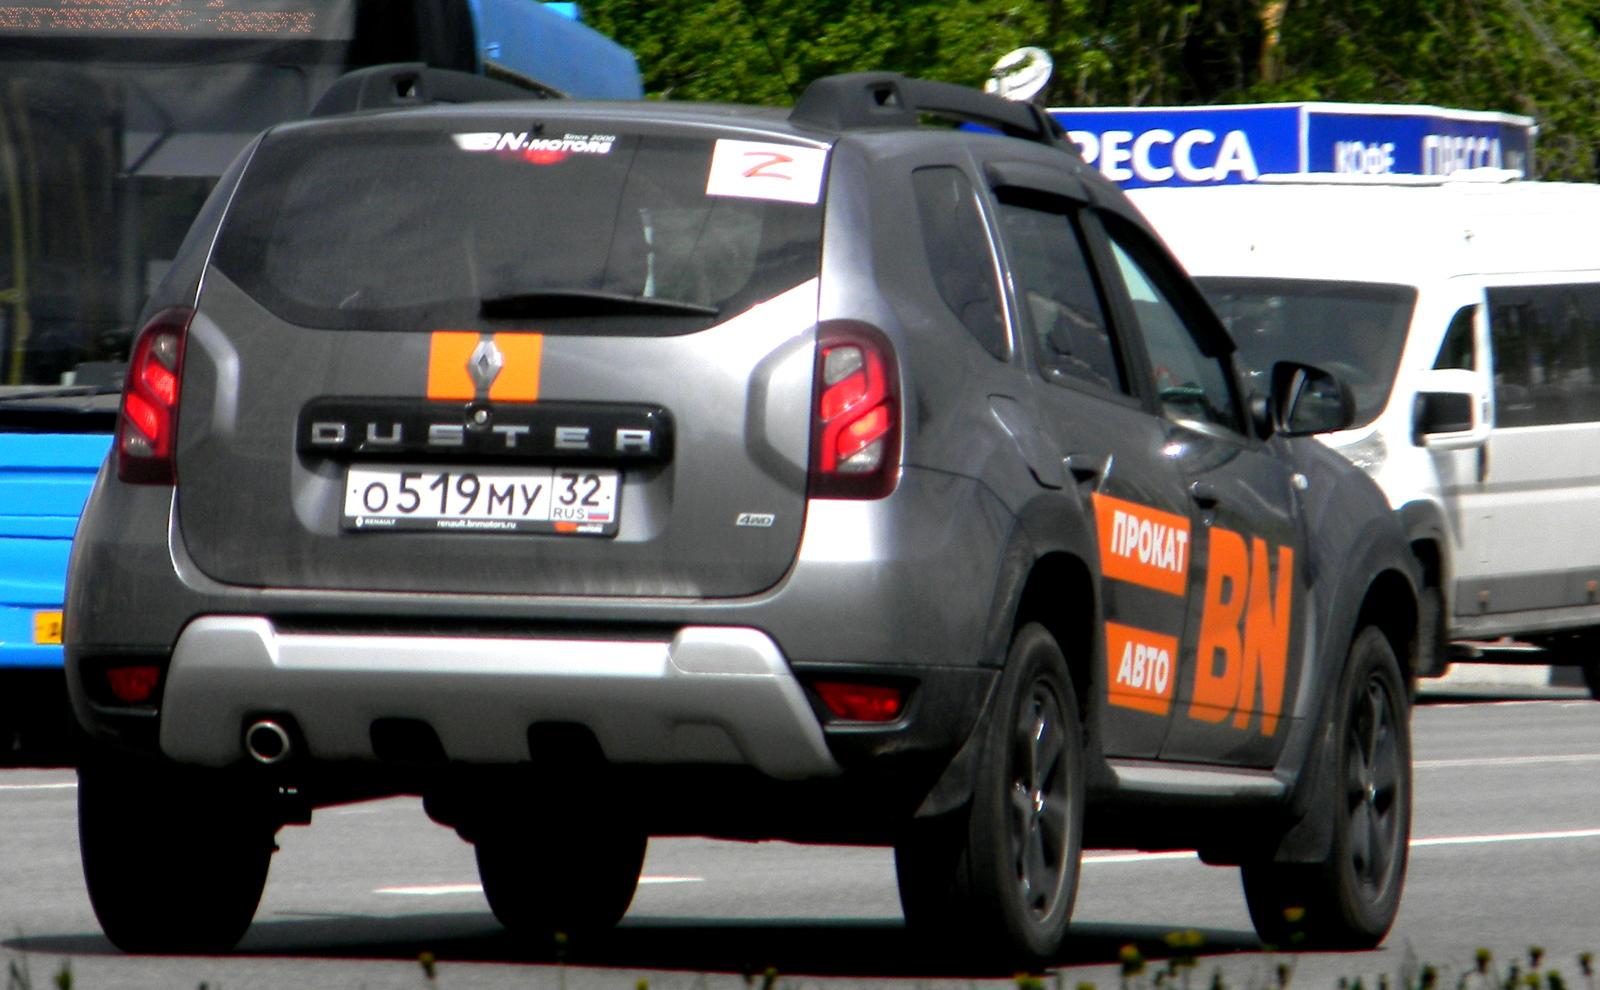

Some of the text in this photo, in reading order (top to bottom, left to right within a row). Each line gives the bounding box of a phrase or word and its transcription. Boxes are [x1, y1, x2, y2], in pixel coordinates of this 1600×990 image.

[563, 133, 616, 142] Since 2000
[311, 422, 652, 450] DUSTER
[558, 473, 600, 506] 32
[364, 518, 517, 529] RENAULT renault.bnmotors.ru
[553, 507, 585, 519] RUS
[737, 513, 774, 526] 4WD
[1111, 510, 1188, 573] ПРОКАТ
[1188, 526, 1294, 737] BN
[1117, 641, 1169, 694] АВТО
